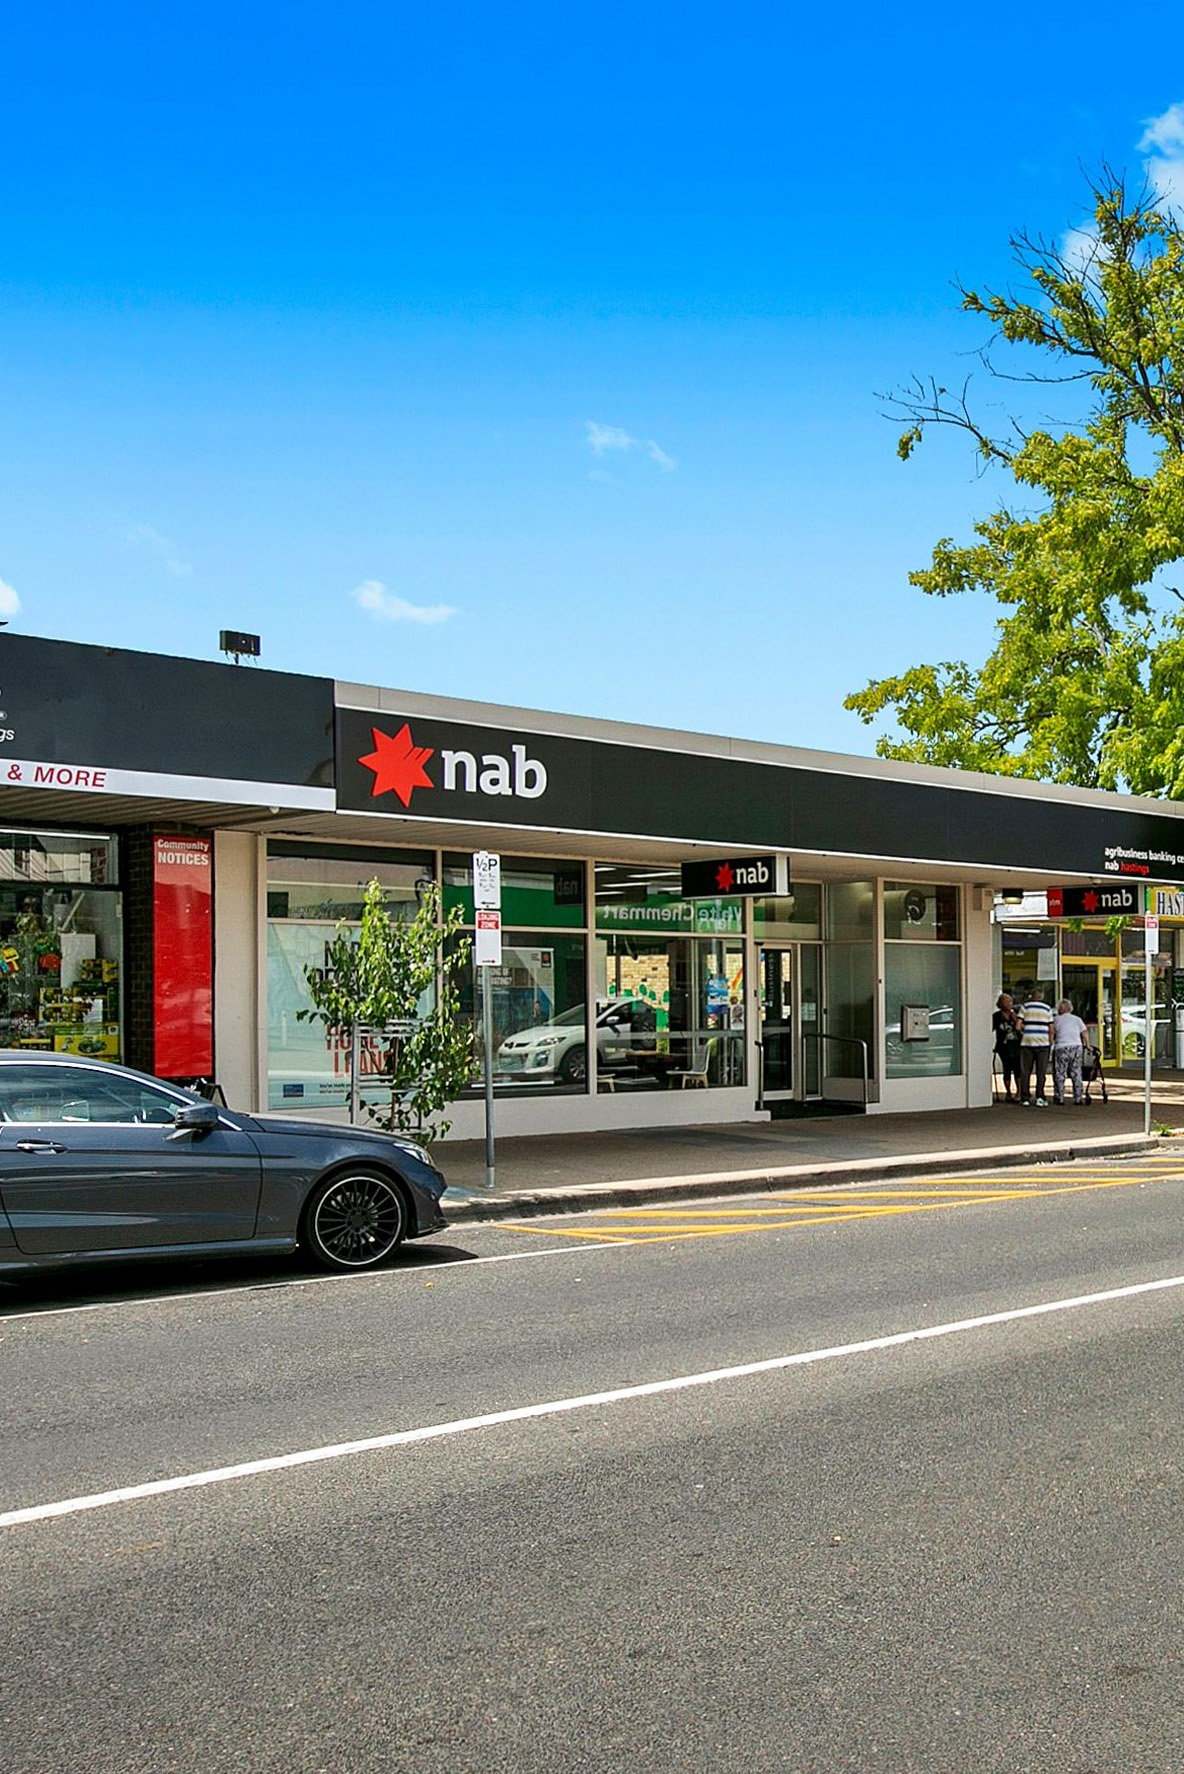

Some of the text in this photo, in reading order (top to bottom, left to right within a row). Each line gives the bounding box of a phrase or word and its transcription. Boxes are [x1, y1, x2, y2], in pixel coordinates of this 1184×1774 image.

[7, 764, 107, 788] & MORE
[441, 745, 547, 799] nab
[157, 839, 209, 852] Community
[158, 852, 209, 866] NOTICES
[1104, 846, 1148, 859] agribusiness
[1148, 850, 1176, 865] banking
[736, 862, 769, 884] nab
[1104, 860, 1149, 875] nab hastings
[1101, 889, 1133, 907] nab
